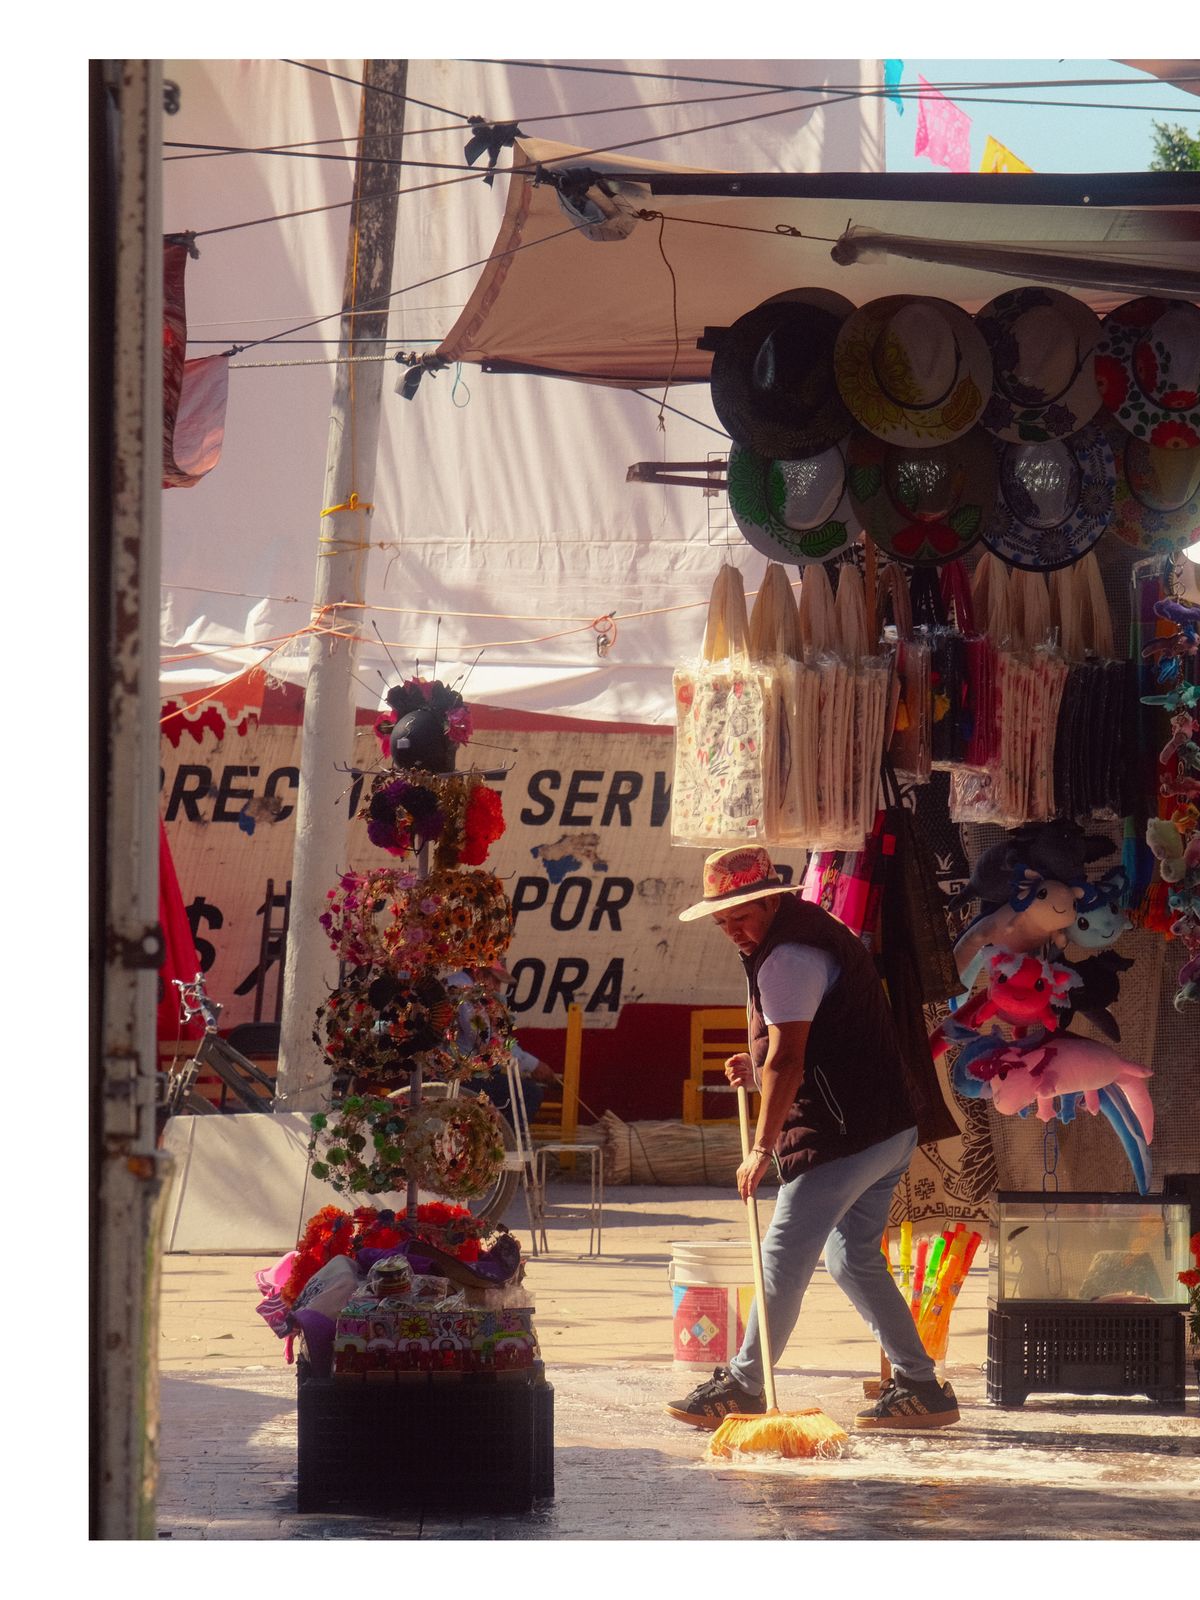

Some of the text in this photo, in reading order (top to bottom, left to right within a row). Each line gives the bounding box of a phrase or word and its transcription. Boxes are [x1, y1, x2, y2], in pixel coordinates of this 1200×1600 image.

[158, 763, 364, 823] REC
[520, 769, 672, 827] SERV
[511, 876, 635, 932] POR
[184, 896, 224, 974] $
[506, 957, 625, 1013] ORA
